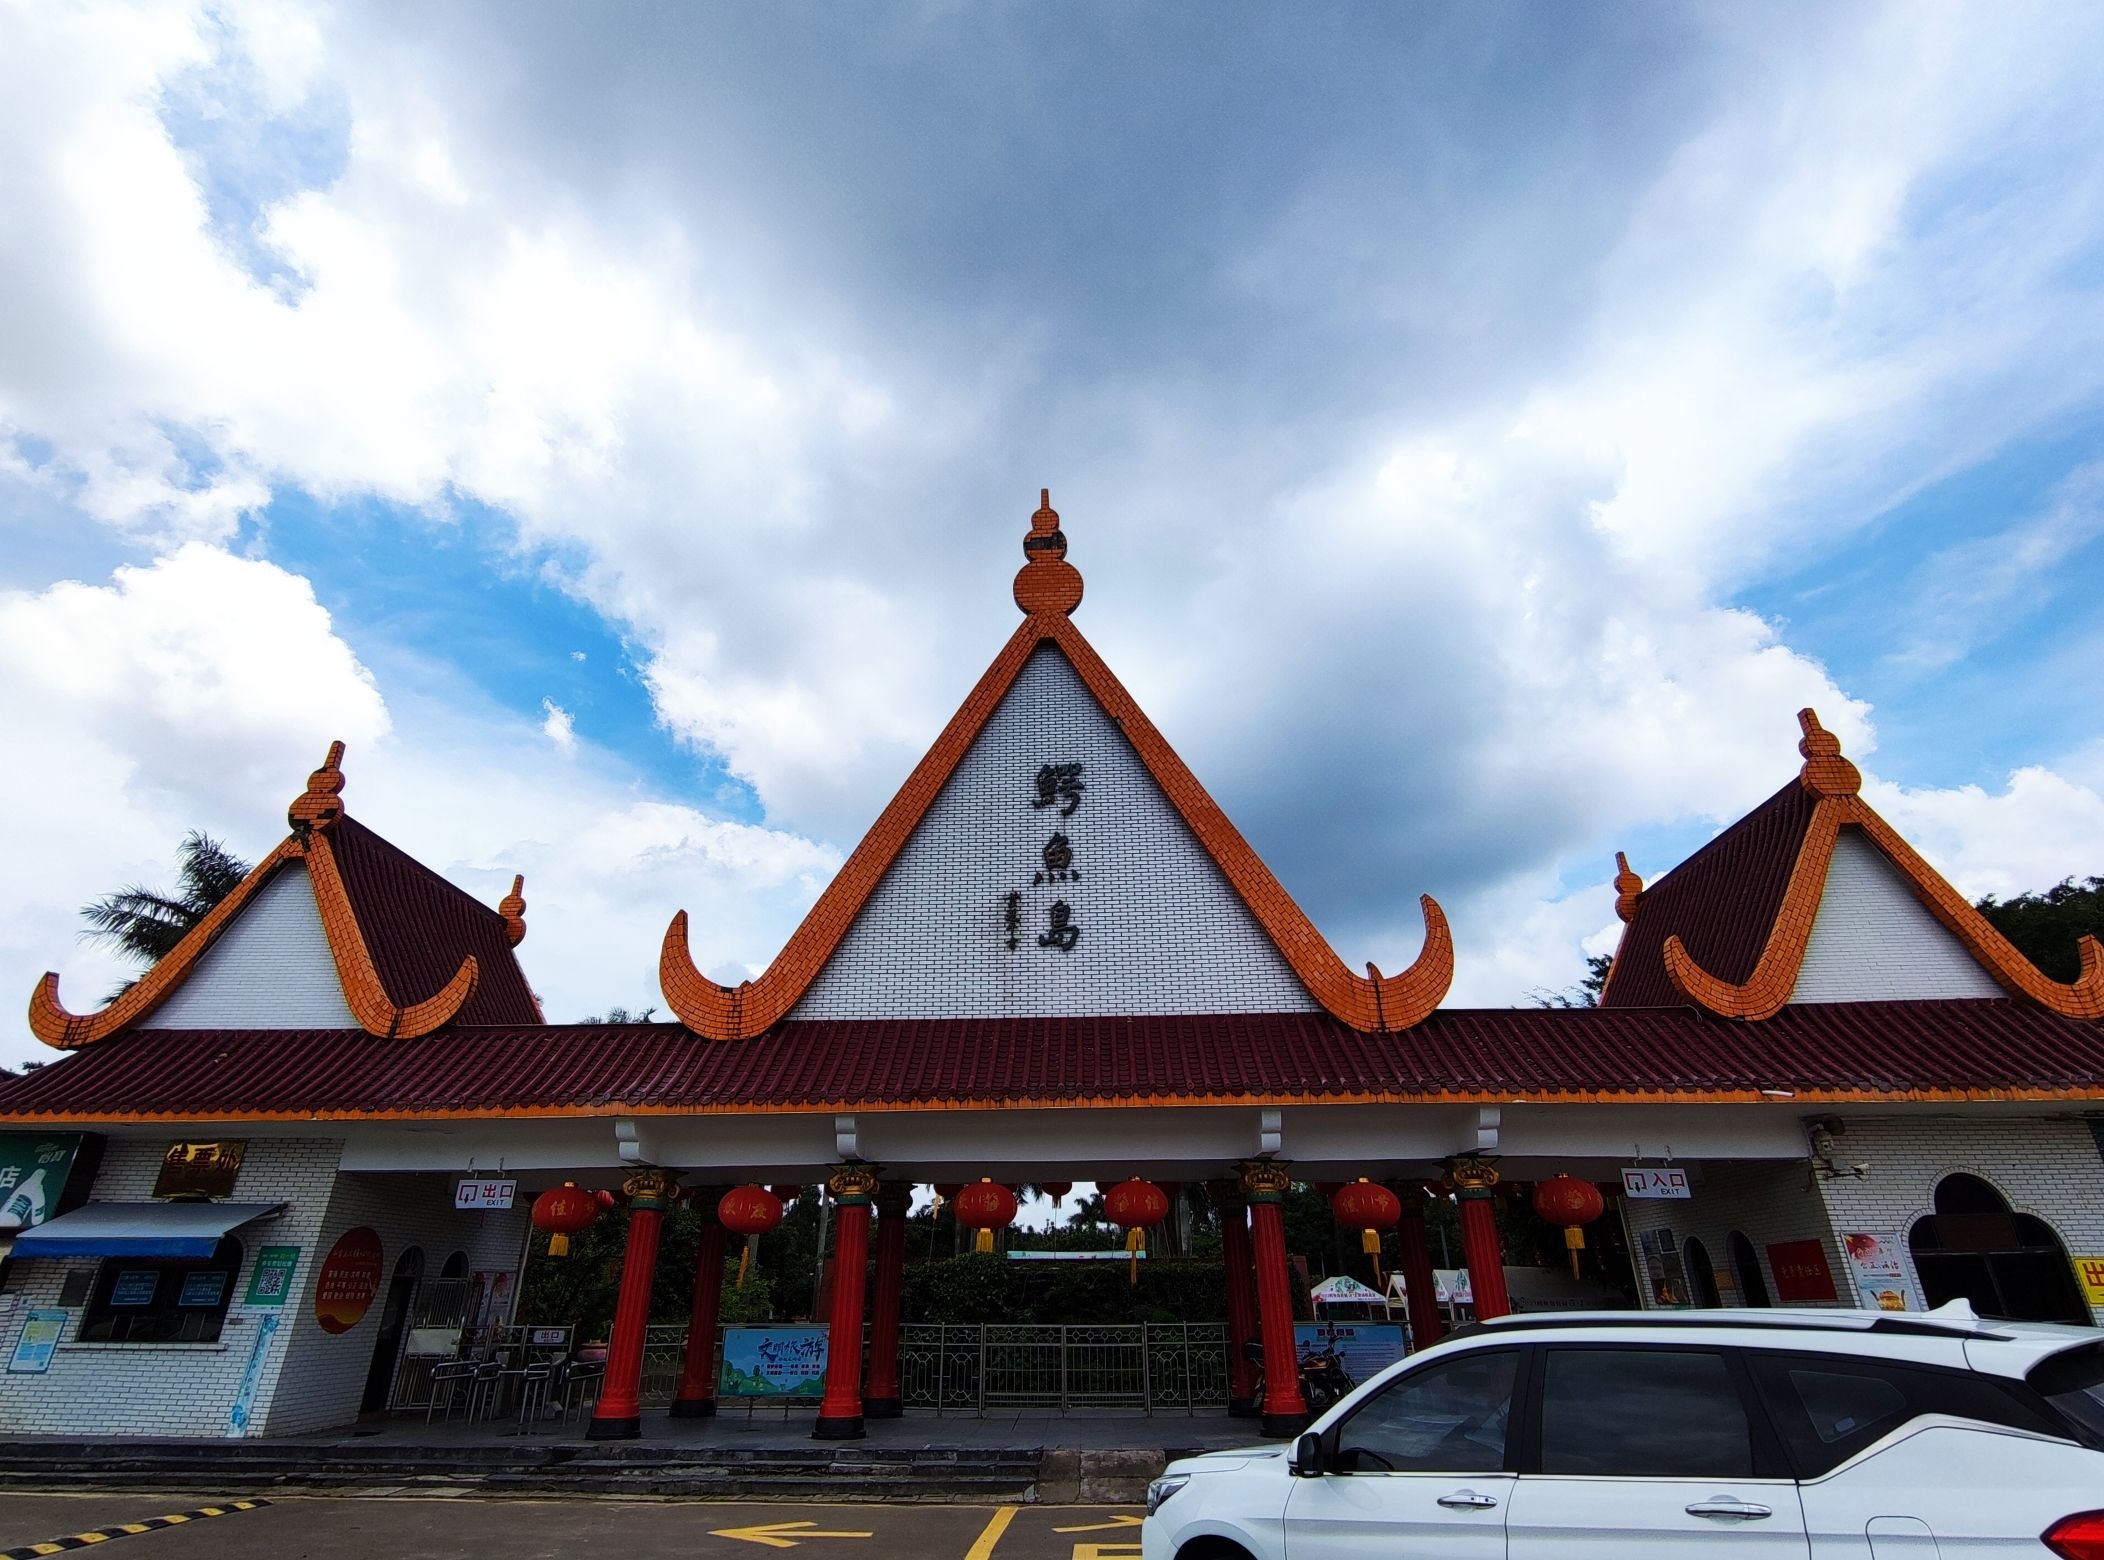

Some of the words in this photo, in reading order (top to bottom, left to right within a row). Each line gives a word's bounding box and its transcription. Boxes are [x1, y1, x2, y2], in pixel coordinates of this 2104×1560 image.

[164, 1145, 241, 1178] 售票处
[1652, 1172, 1685, 1187] 入口
[482, 1184, 513, 1198] 出口
